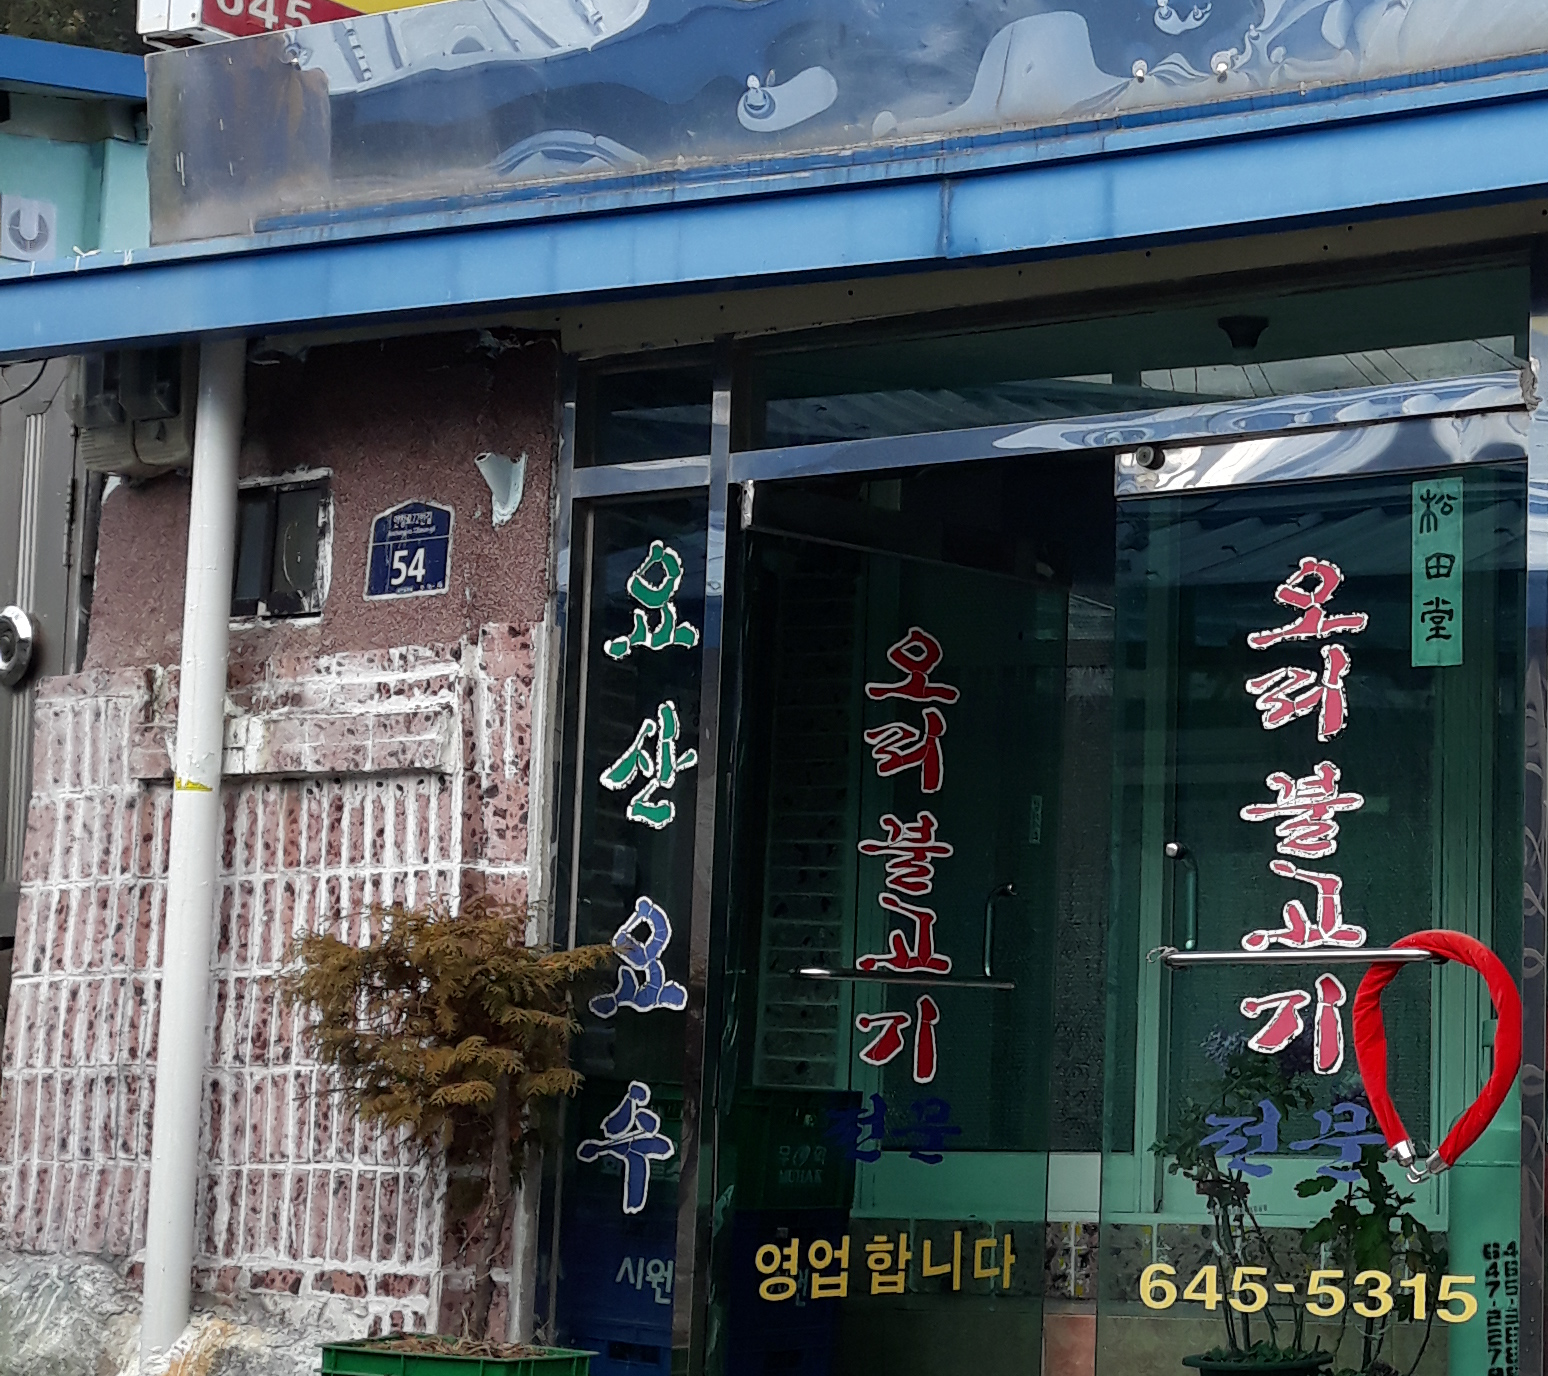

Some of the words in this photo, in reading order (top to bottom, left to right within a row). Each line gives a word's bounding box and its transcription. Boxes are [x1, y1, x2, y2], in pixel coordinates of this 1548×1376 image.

[390, 547, 427, 586] 54
[577, 539, 700, 1215] 요산요수
[825, 1092, 962, 1165] 전문
[1201, 1099, 1386, 1182] 전문
[1139, 1262, 1478, 1324] 645-5315
